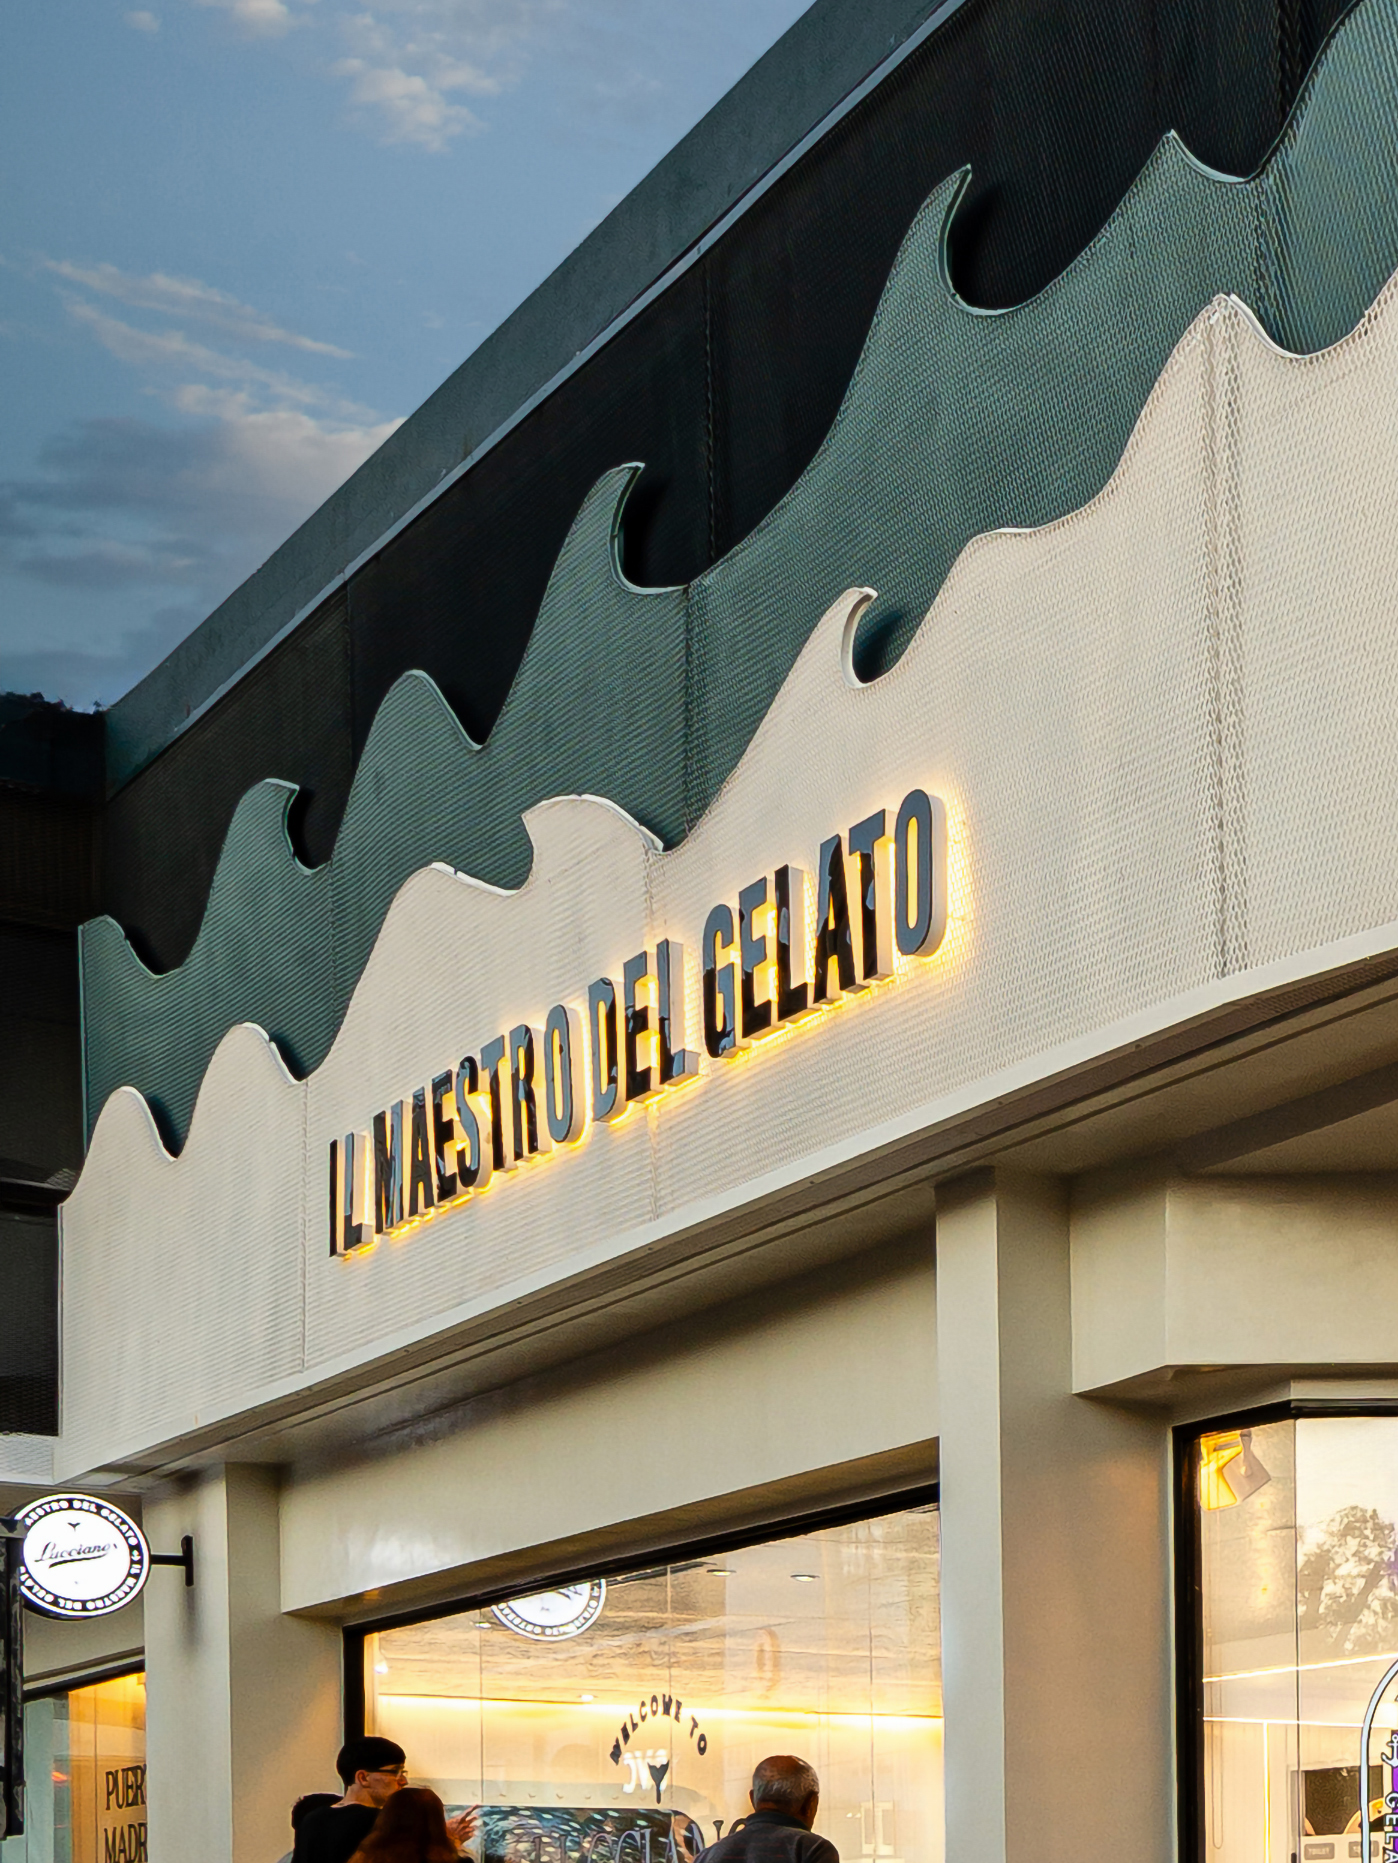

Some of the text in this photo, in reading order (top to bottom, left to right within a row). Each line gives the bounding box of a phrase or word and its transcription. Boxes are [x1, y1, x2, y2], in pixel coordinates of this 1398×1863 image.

[329, 787, 939, 1258] IL MAESTRO DEL GELATO
[24, 1499, 139, 1546] AESTRO DEL GELATO
[34, 1541, 118, 1568] Lucciano
[609, 1693, 708, 1766] WELCOME TO
[105, 1764, 147, 1811] PUER
